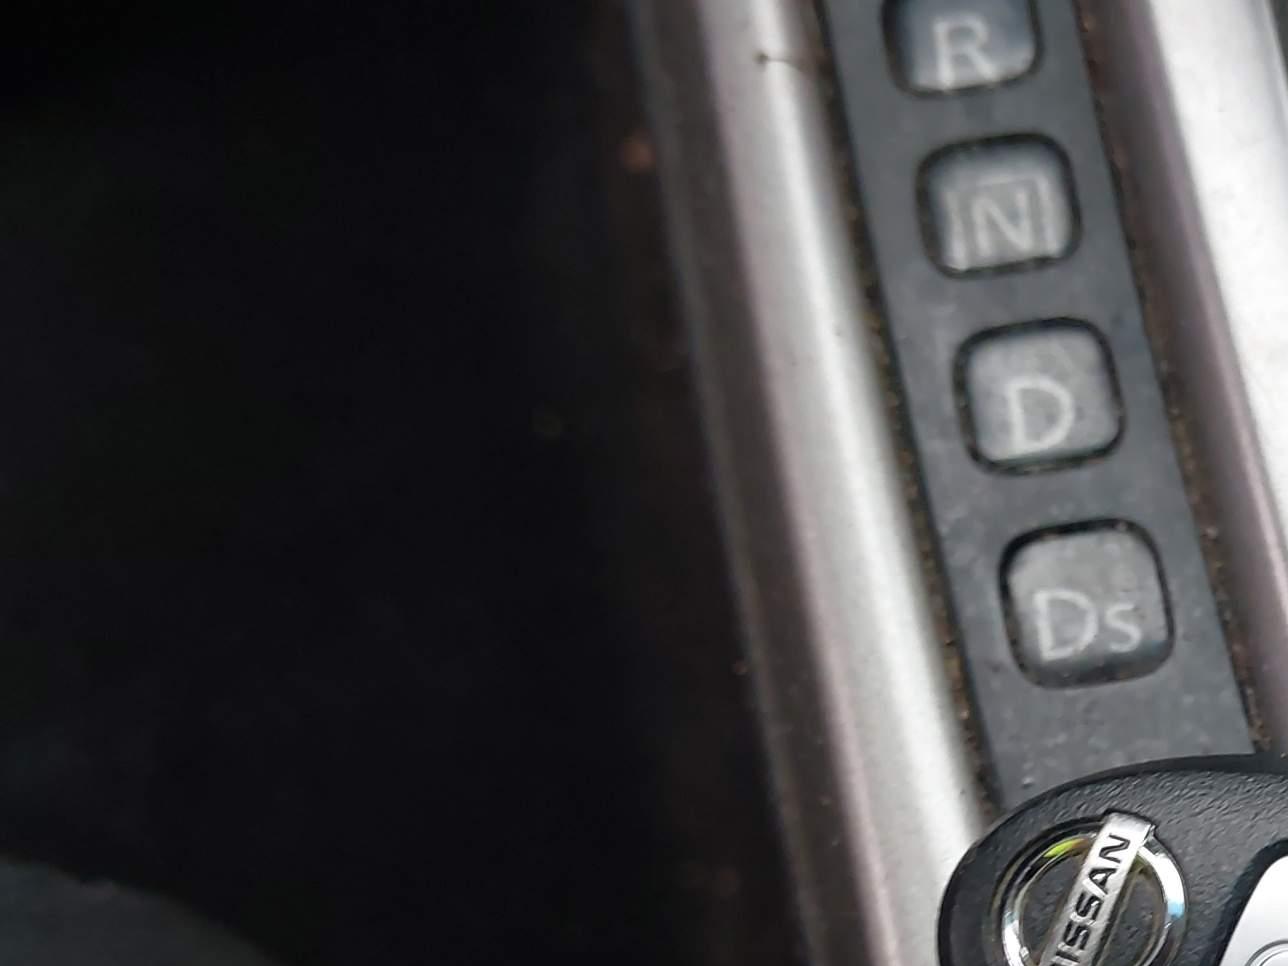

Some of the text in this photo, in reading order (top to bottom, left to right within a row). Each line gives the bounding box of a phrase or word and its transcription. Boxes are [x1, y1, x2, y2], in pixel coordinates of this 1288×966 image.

[933, 13, 999, 90] R
[969, 182, 1036, 256] N
[1007, 377, 1074, 450] D
